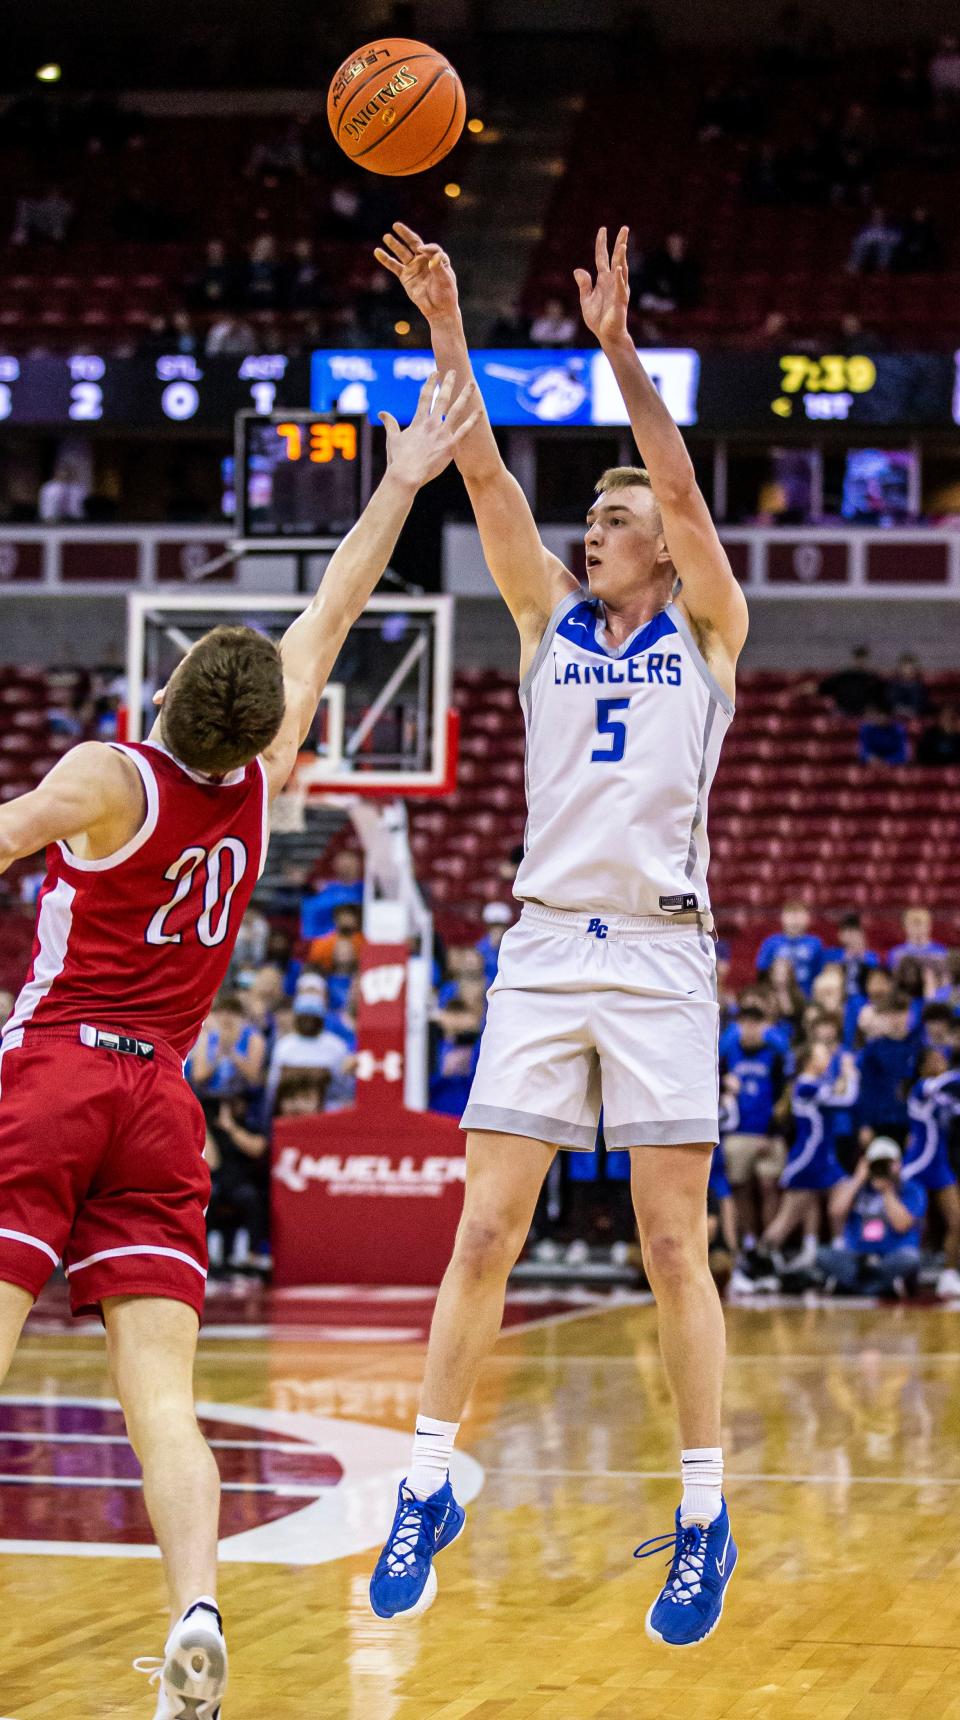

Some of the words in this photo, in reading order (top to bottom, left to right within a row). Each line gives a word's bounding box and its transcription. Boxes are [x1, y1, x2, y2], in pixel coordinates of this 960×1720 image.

[333, 49, 390, 107] LEGACY
[344, 66, 418, 141] SPALDING
[157, 355, 204, 381] STL
[779, 355, 877, 393] 7:39
[69, 382, 103, 420] 2
[161, 381, 199, 421] 0
[250, 381, 276, 416] 1
[803, 392, 853, 420] 1ST
[553, 652, 682, 687] LANCERS
[590, 697, 631, 762] 5
[144, 834, 247, 947] 20
[686, 897, 694, 907] M
[586, 918, 608, 939] BC
